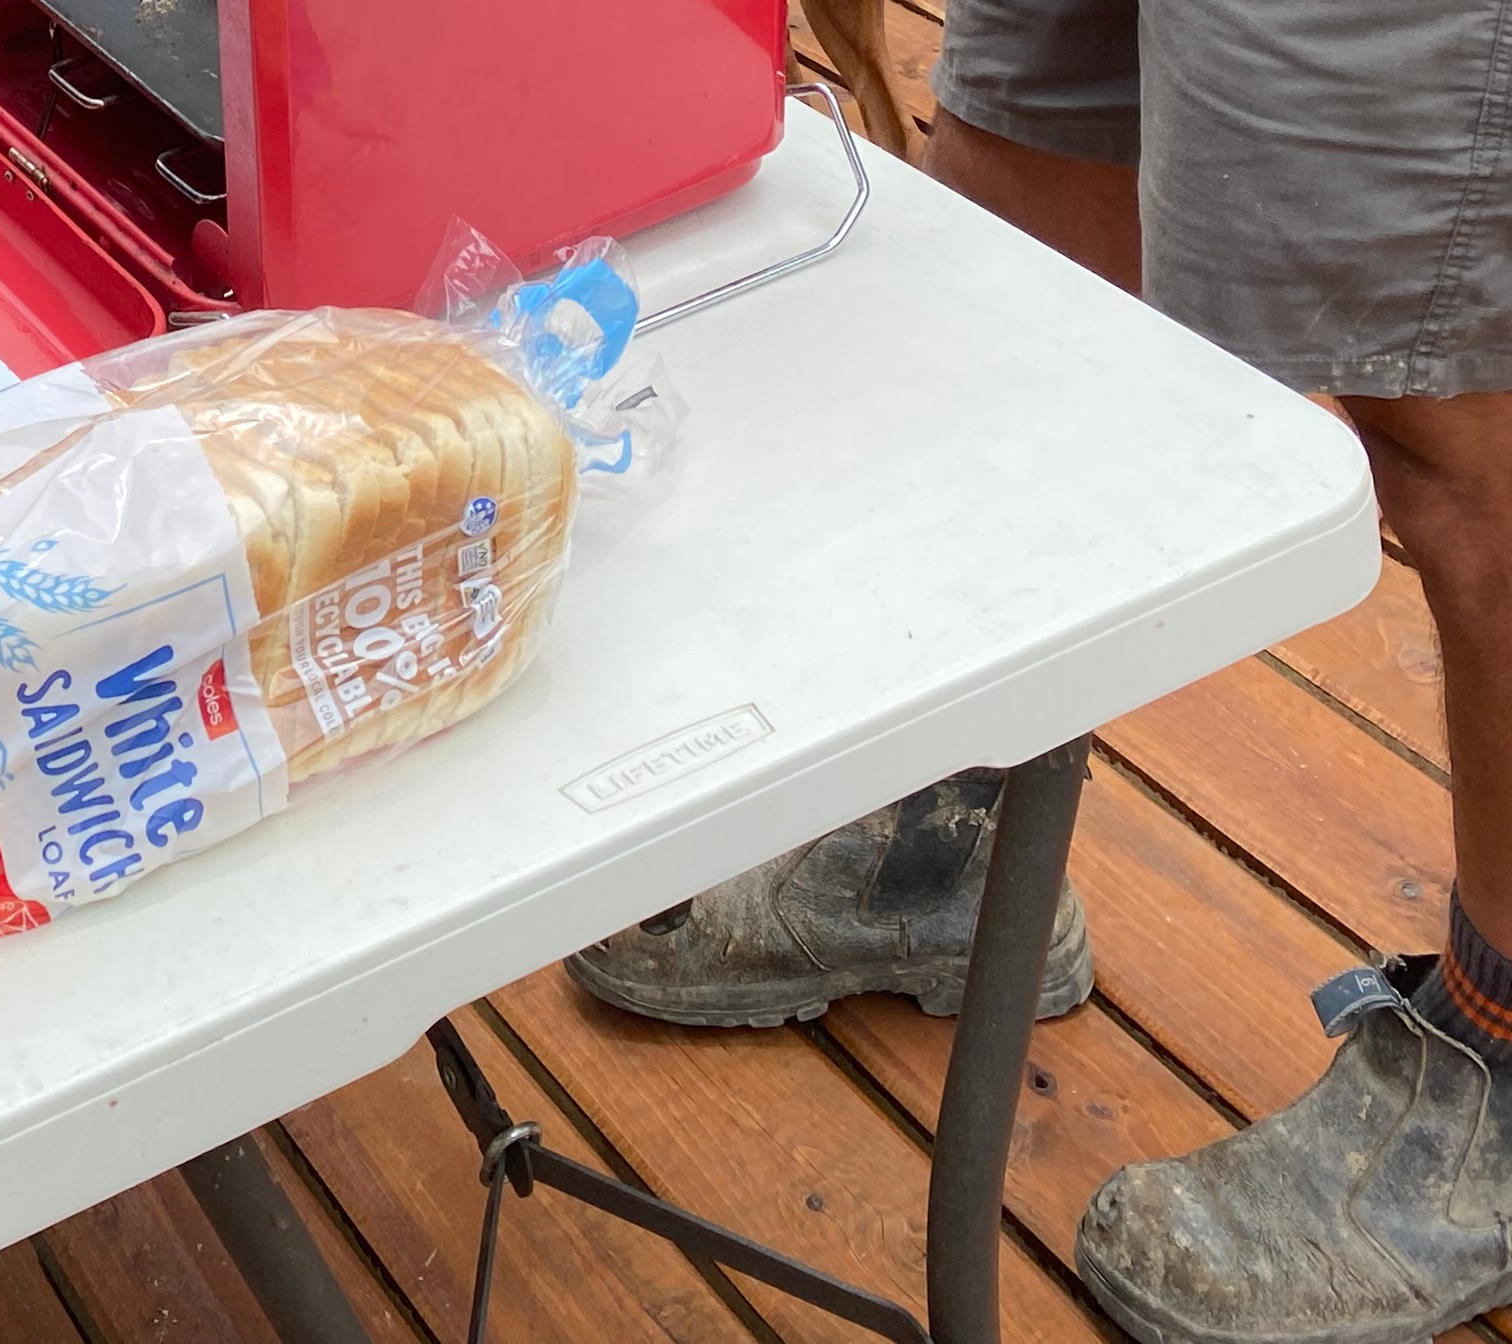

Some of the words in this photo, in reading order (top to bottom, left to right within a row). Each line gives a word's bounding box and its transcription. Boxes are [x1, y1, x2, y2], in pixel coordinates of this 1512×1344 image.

[397, 546, 425, 610] THIS
[343, 559, 418, 708] 100%
[201, 675, 224, 726] coles
[94, 644, 204, 847] White
[587, 721, 751, 800] LIFETIME
[37, 826, 77, 901] LOAF
